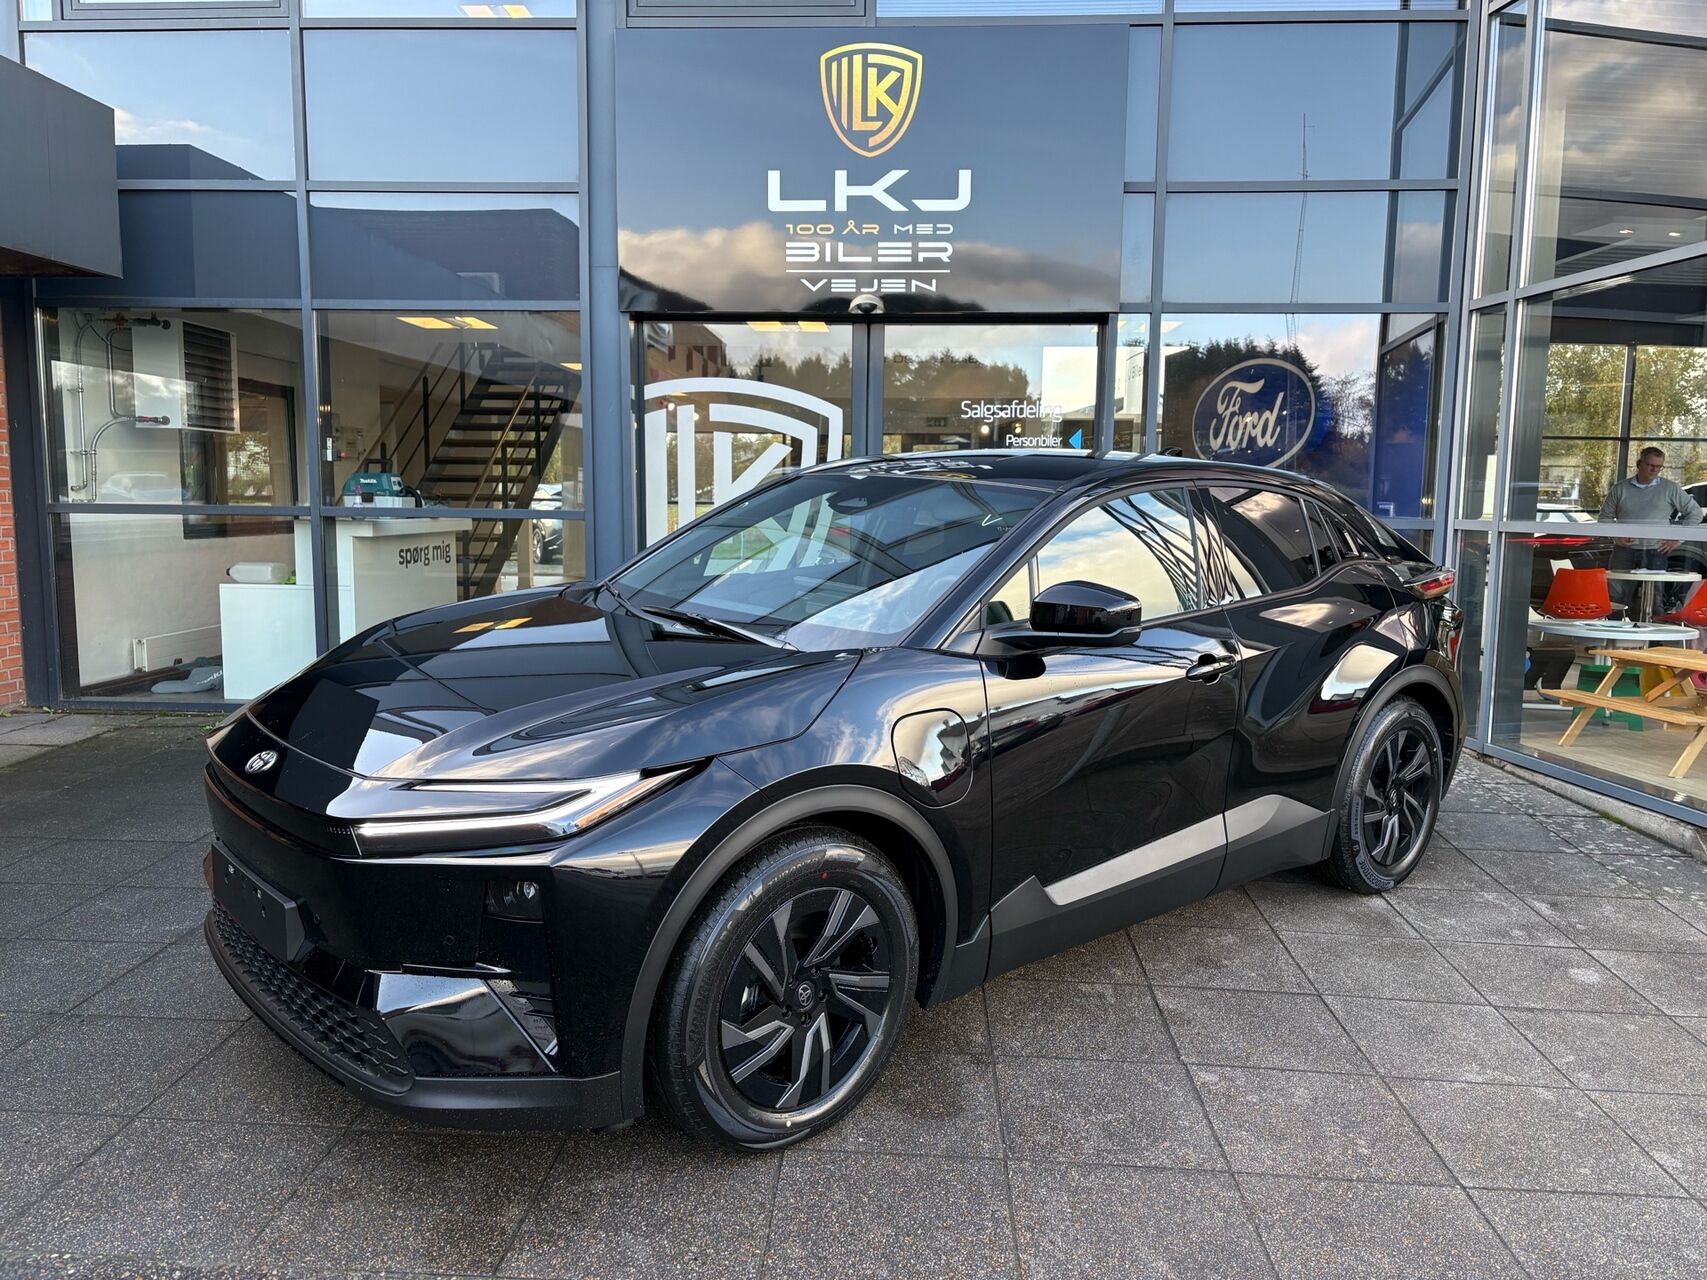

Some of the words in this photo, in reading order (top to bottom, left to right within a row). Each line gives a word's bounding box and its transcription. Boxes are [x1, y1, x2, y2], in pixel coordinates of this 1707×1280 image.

[767, 169, 972, 212] LKJ
[785, 223, 835, 235] 100
[841, 219, 880, 235] ÅR
[893, 223, 954, 235] MED
[785, 241, 954, 263] BILER
[799, 278, 937, 293] VEJEN
[960, 400, 1063, 423] Salgsafdeling
[1209, 378, 1285, 450] Ford
[1005, 434, 1063, 447] Personbiler
[398, 544, 431, 569] spørg
[432, 539, 452, 564] mig
